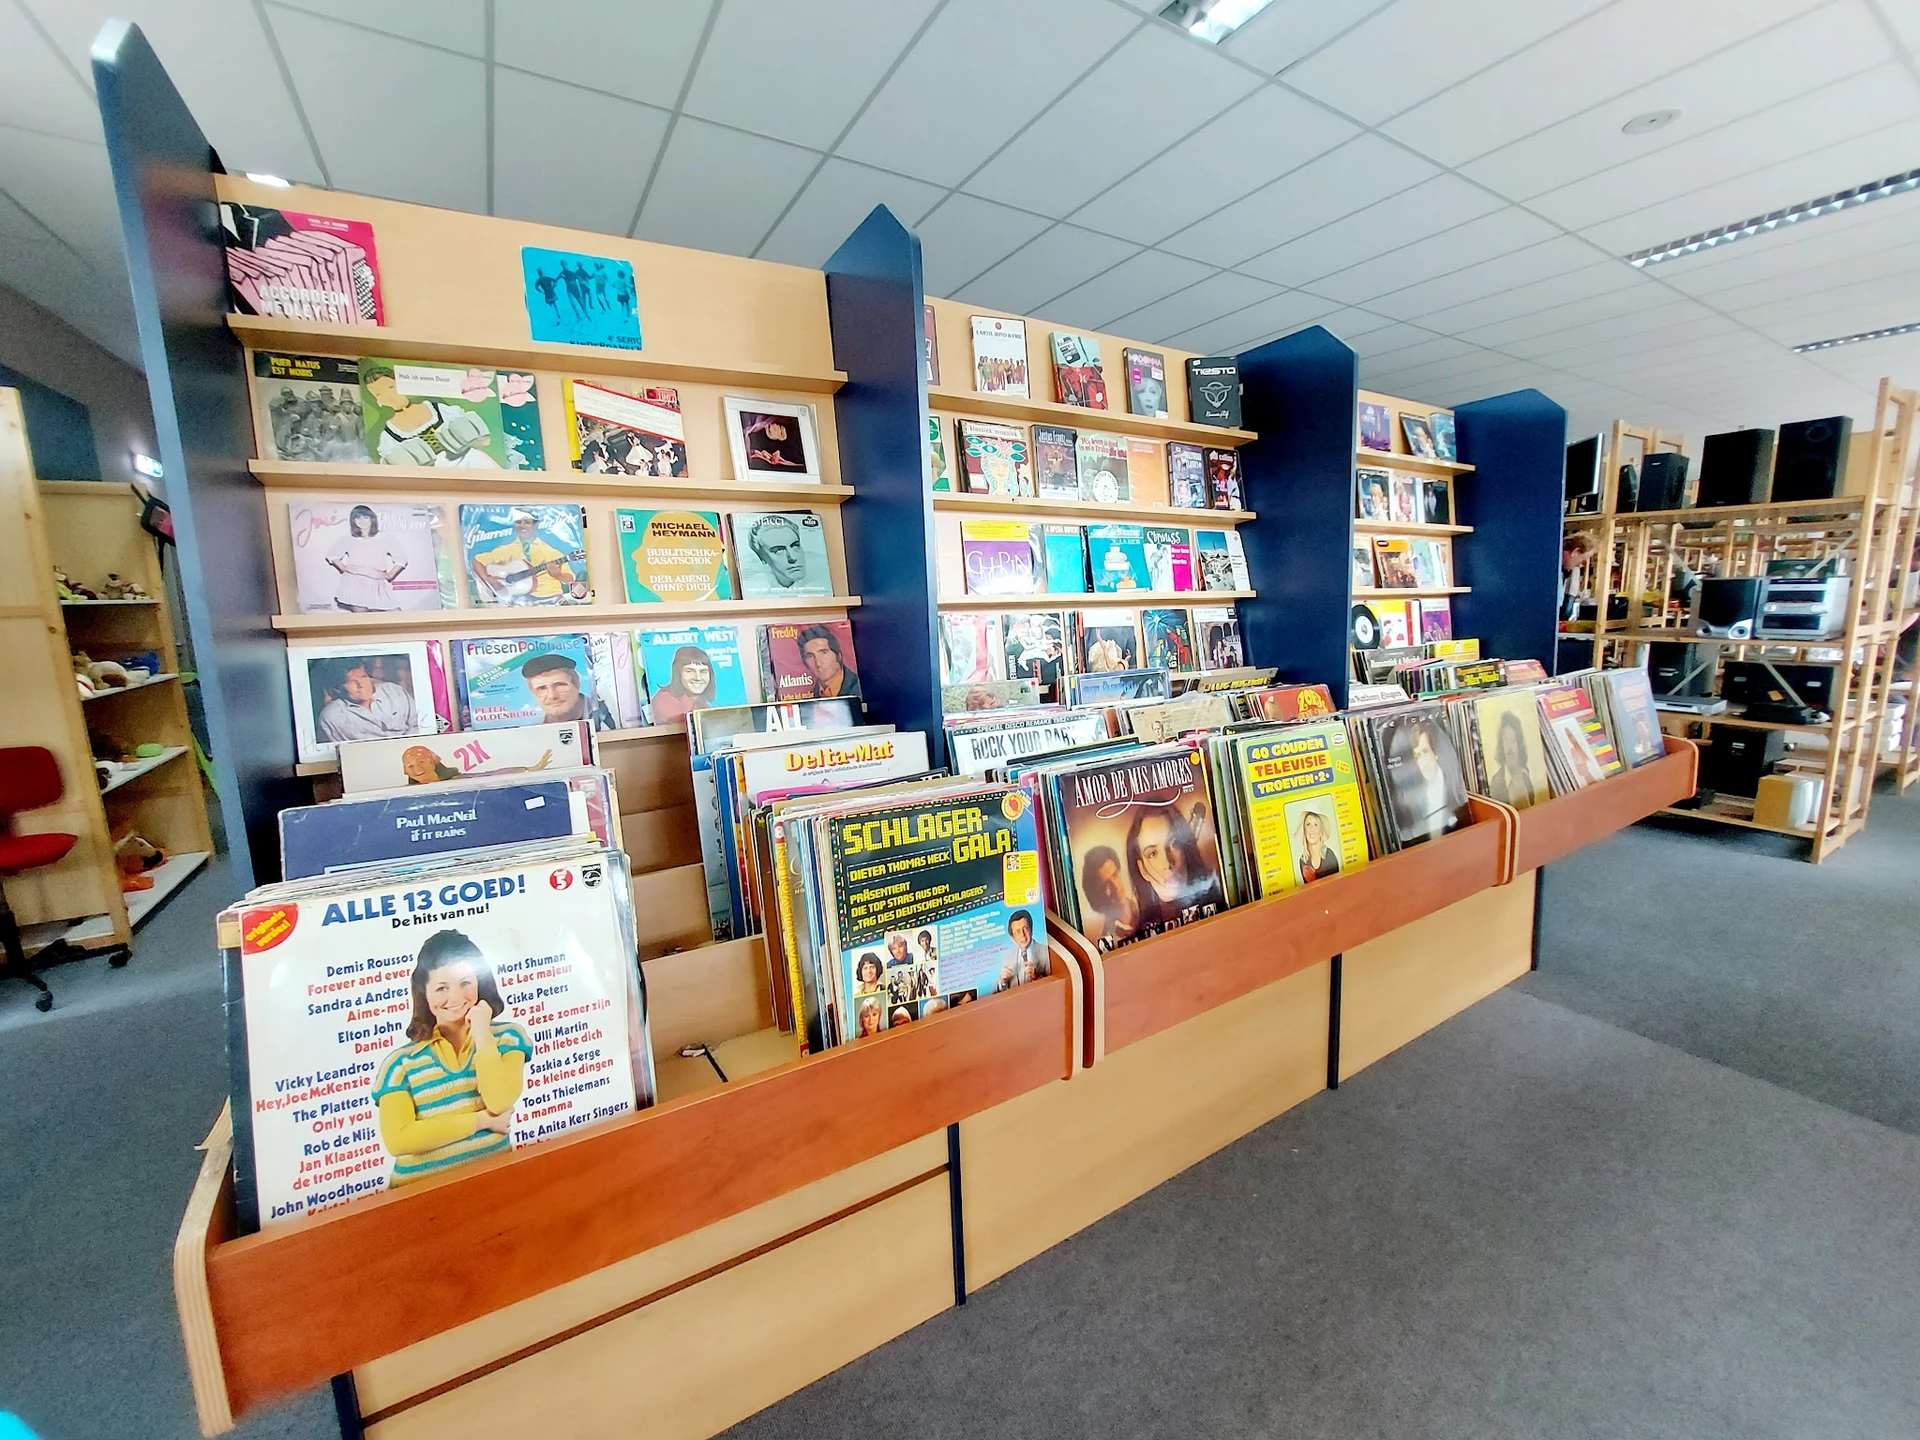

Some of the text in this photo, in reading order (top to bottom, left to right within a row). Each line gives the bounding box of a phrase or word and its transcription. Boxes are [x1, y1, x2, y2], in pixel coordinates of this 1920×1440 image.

[271, 366, 286, 375] EST
[295, 360, 321, 369] NATUS
[651, 522, 709, 531] MICHAEL
[652, 530, 716, 538] HEYMANN
[647, 557, 712, 565] CASATSCHOK
[649, 575, 710, 584] DER ABEND
[653, 582, 711, 591] OHNE DICH
[653, 630, 734, 646] ALBERT WEST
[772, 626, 798, 640] Freddy
[780, 672, 813, 688] Atlantis
[475, 705, 506, 715] PETER
[475, 710, 537, 723] OLDENBURG
[976, 725, 1004, 733] SPECIAL
[1005, 723, 1025, 731] DISCO
[1026, 718, 1051, 727] REMAKE
[785, 740, 894, 772] Delta-Mat
[971, 734, 1008, 760] ROCK
[1007, 730, 1042, 754] YOUR
[1252, 737, 1325, 760] 40 GOUDEN
[1255, 754, 1327, 777] TELEVISIE
[1075, 757, 1194, 808] AMOR DE MIS AMORES
[843, 807, 989, 855] SCHLAGER-
[953, 829, 1012, 864] GALA
[850, 851, 951, 882] DIETER THOMAS HECK
[556, 875, 567, 890] 5
[850, 881, 911, 905] PRÄSENTIERT
[321, 874, 526, 927] ALLE 13 GOED!
[851, 883, 950, 918] DIE TOP STARS AUS DEM
[878, 910, 895, 923] DES
[896, 897, 943, 920] DEUTSCHEN
[392, 902, 491, 929] De hits van nu!
[326, 952, 414, 977] Demis Roussos
[497, 953, 566, 975] Mort Shuman
[501, 963, 573, 987] Le Lac majeur
[307, 967, 411, 997] Forever and ever
[308, 998, 352, 1016] Sandra
[365, 986, 410, 1004] Andres
[506, 983, 569, 1006] Ciska Peters
[347, 999, 410, 1023] Aime-moi
[512, 1001, 545, 1019] Zo zal
[527, 998, 611, 1027] deze zomer zijn
[338, 1020, 403, 1043] Elton John
[534, 1021, 589, 1043] Ulli Martin
[534, 1028, 603, 1056] Ich liebe dich
[354, 1036, 394, 1055] Daniel
[530, 1058, 562, 1075] Saskia
[572, 1048, 601, 1064] Serge
[275, 1061, 375, 1093] Vicky Leandros
[527, 1058, 614, 1090] De kleine dingen
[523, 1075, 611, 1108] Toots Thielemans
[293, 1096, 370, 1123] The Platters
[312, 1110, 373, 1133] Only you
[515, 1100, 630, 1143] The Anita Kerr Singers
[516, 1100, 573, 1124] La mamma
[303, 1127, 377, 1156] Rob de Nijs
[299, 1142, 380, 1174] Jan Klaassen
[292, 1155, 386, 1191] de trompetter
[270, 1200, 304, 1219] John
[306, 1174, 384, 1206] Woodhouse
